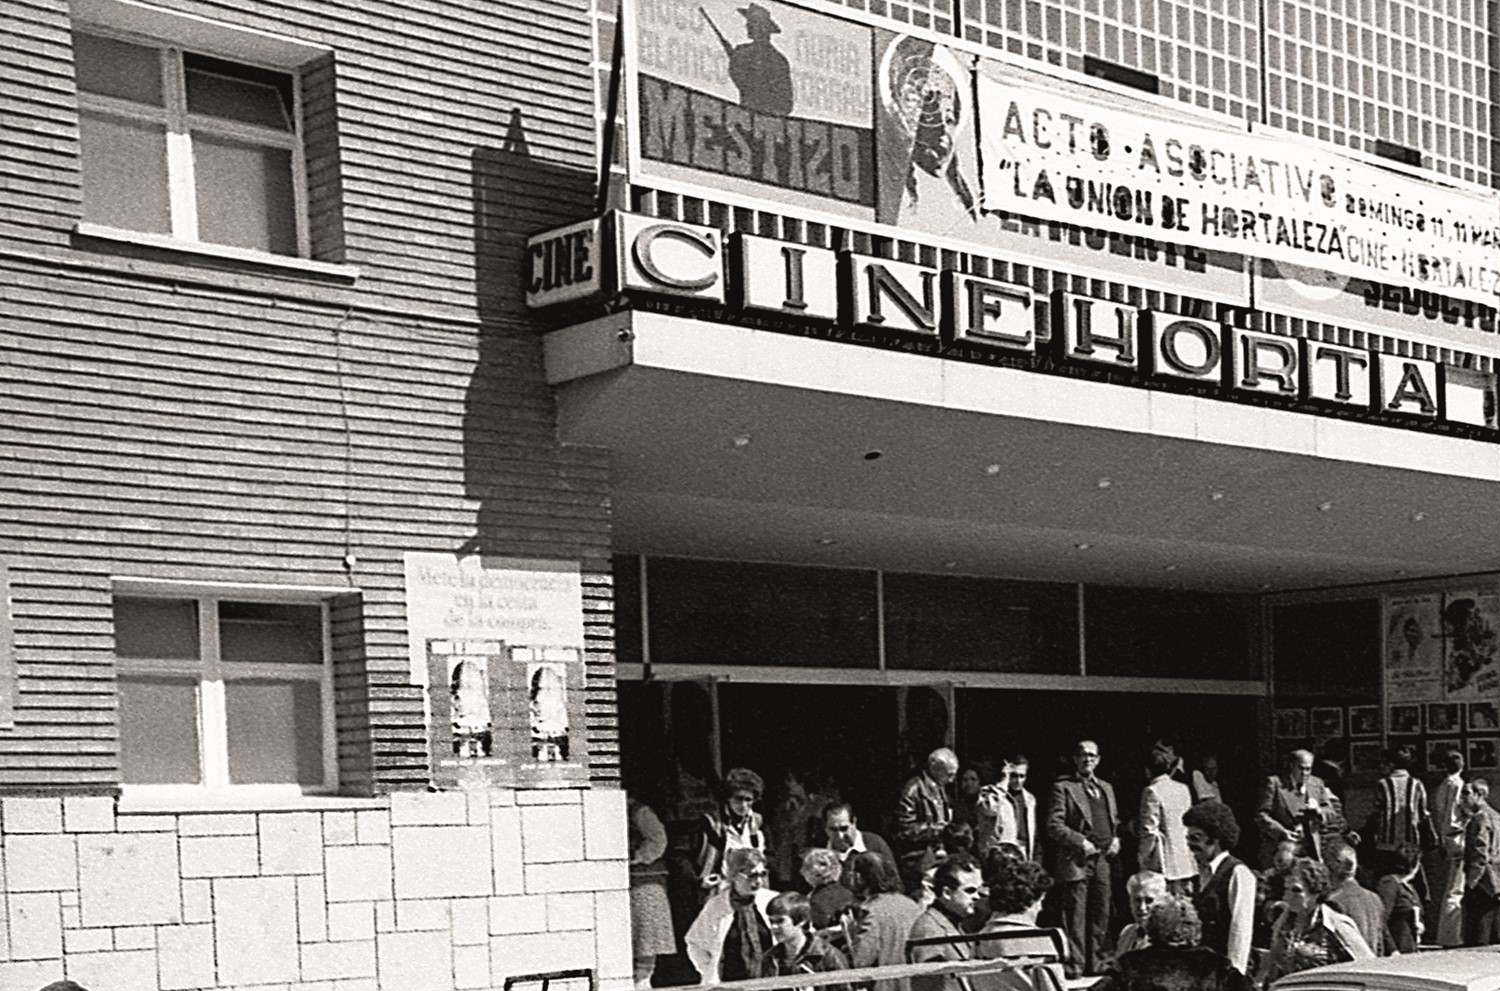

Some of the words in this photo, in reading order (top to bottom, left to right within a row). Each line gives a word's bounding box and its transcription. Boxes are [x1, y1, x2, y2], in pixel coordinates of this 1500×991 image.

[644, 78, 860, 201] MESTIZO
[1065, 175, 1154, 226] UNION
[1161, 194, 1190, 231] DE
[526, 229, 594, 294] CINE
[632, 223, 1033, 346] CINE
